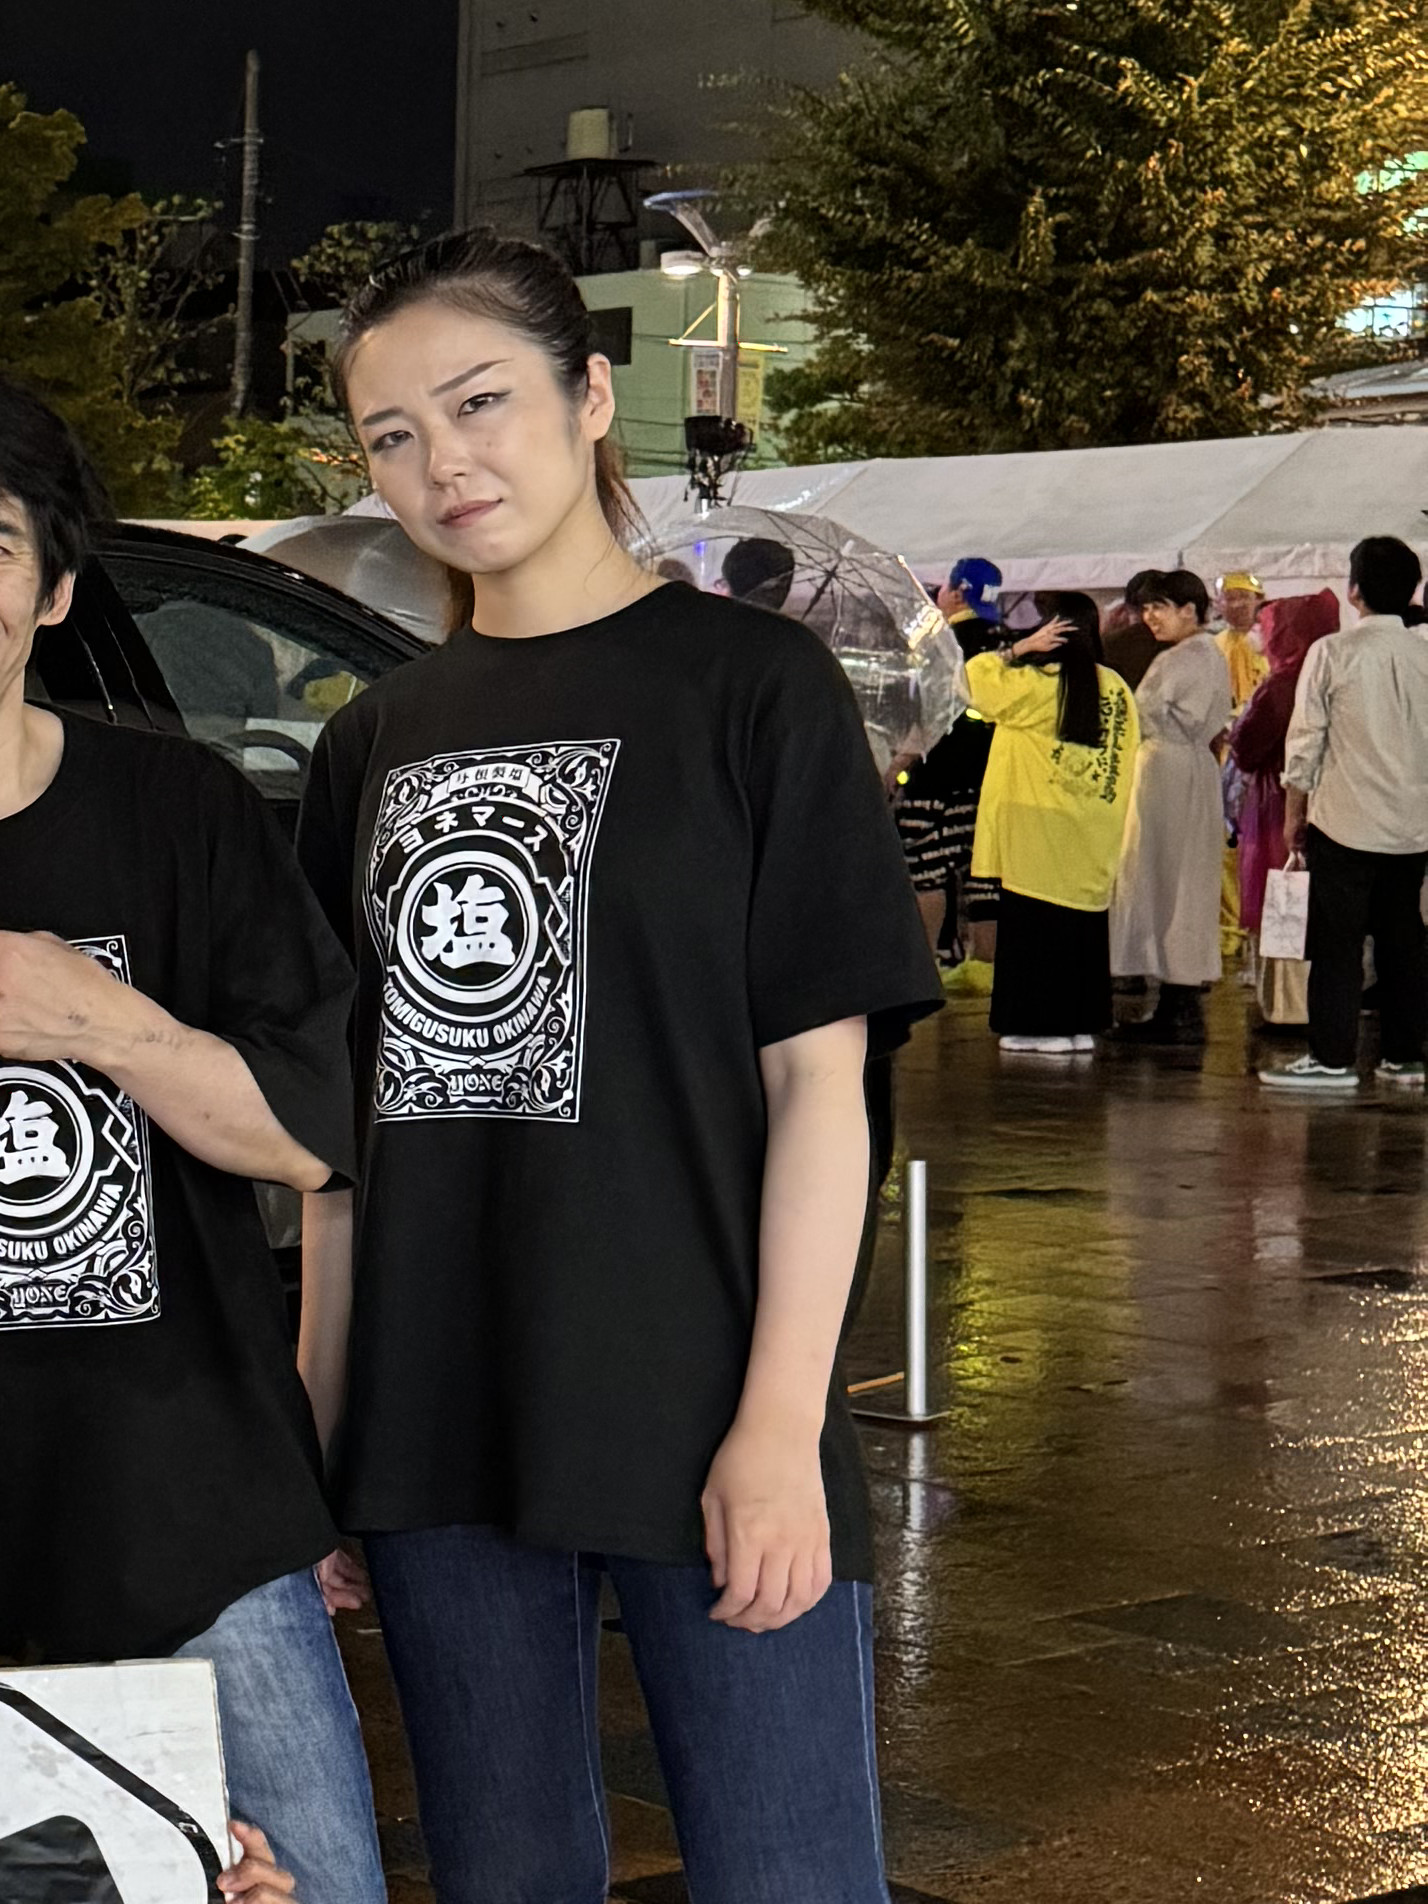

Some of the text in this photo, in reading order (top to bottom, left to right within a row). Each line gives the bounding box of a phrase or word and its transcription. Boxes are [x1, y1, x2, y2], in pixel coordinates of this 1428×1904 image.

[399, 805, 549, 852] ヨネマース
[420, 874, 516, 969] 塩
[493, 975, 551, 1044] OKINAWA
[53, 1184, 124, 1255] OKINAWA
